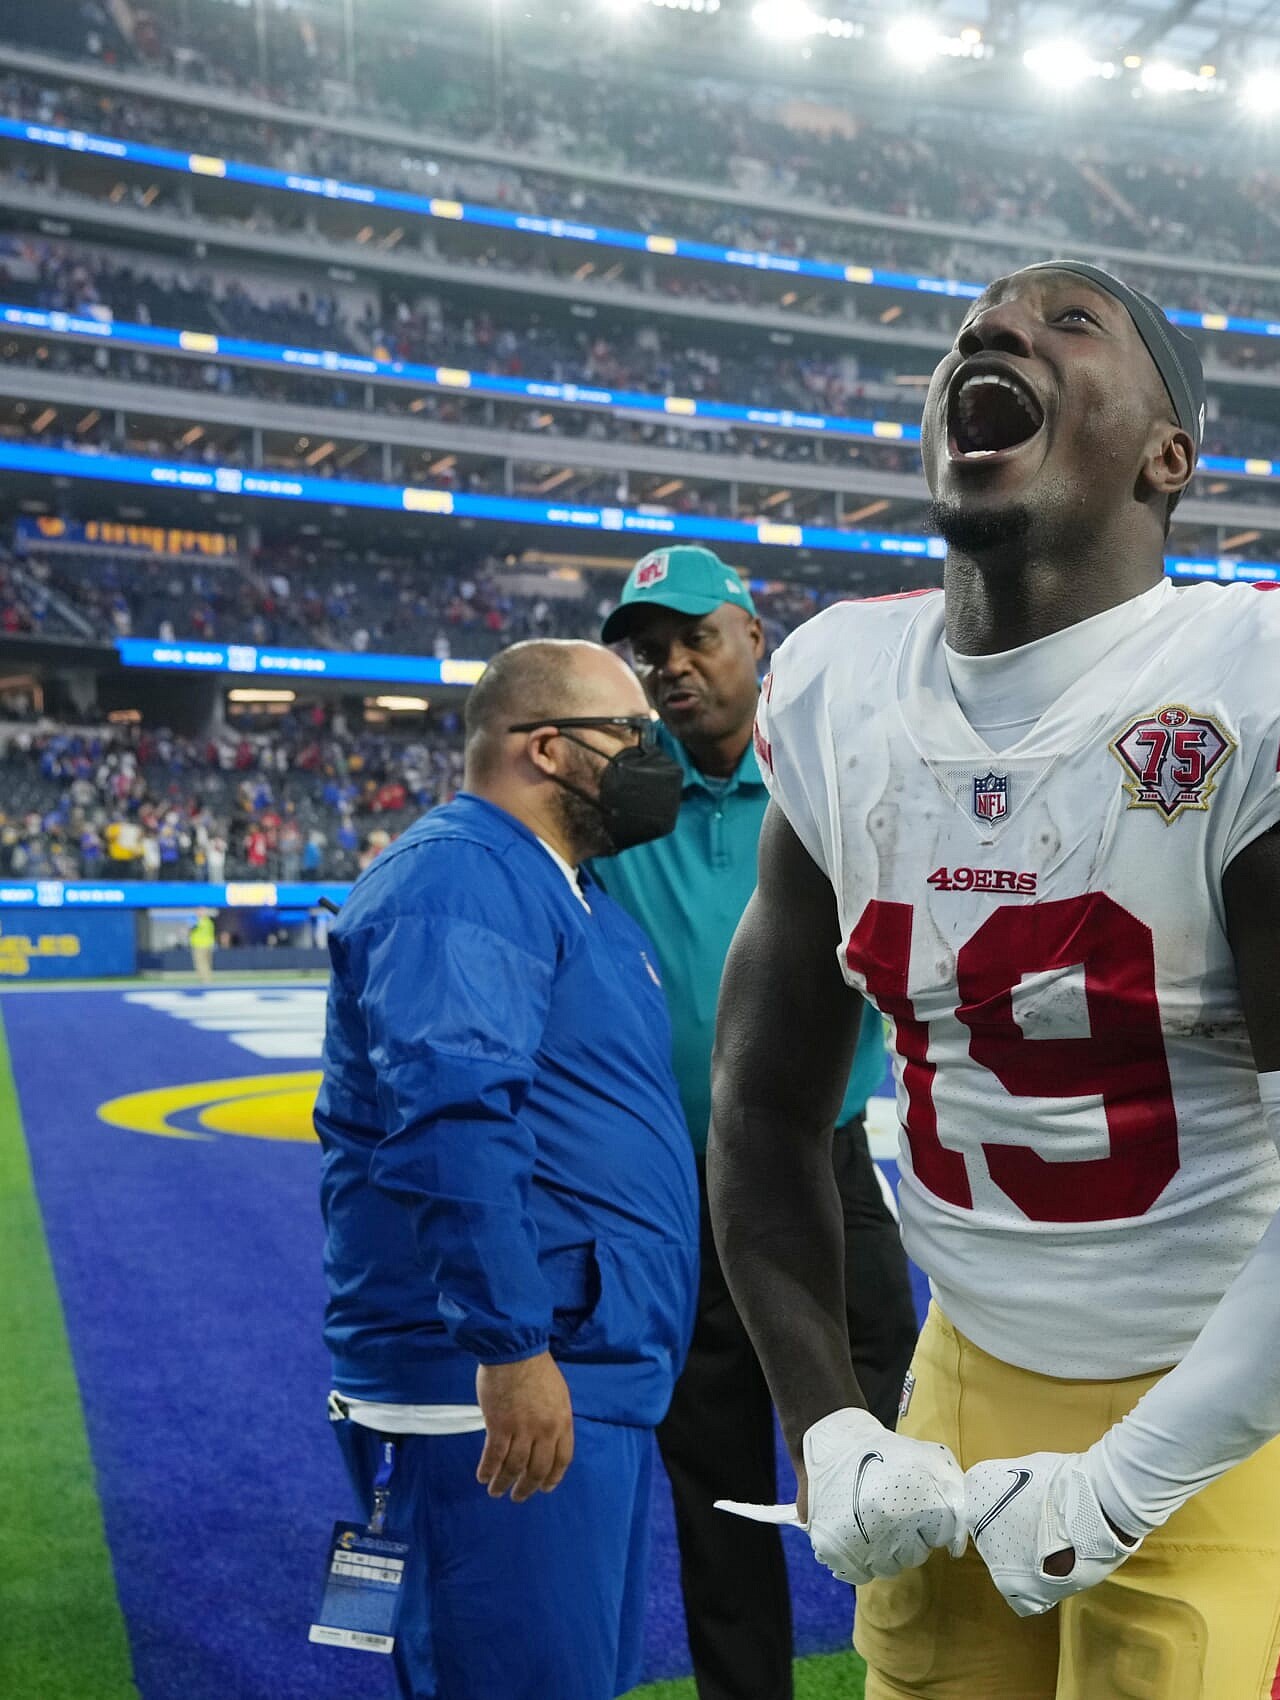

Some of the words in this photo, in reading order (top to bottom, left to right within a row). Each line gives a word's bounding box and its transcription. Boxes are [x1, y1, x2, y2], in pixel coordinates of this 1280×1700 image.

[1136, 729, 1207, 786] 75
[977, 793, 1005, 817] NFL
[926, 866, 1038, 895] 49ERS
[846, 891, 1180, 1223] 19
